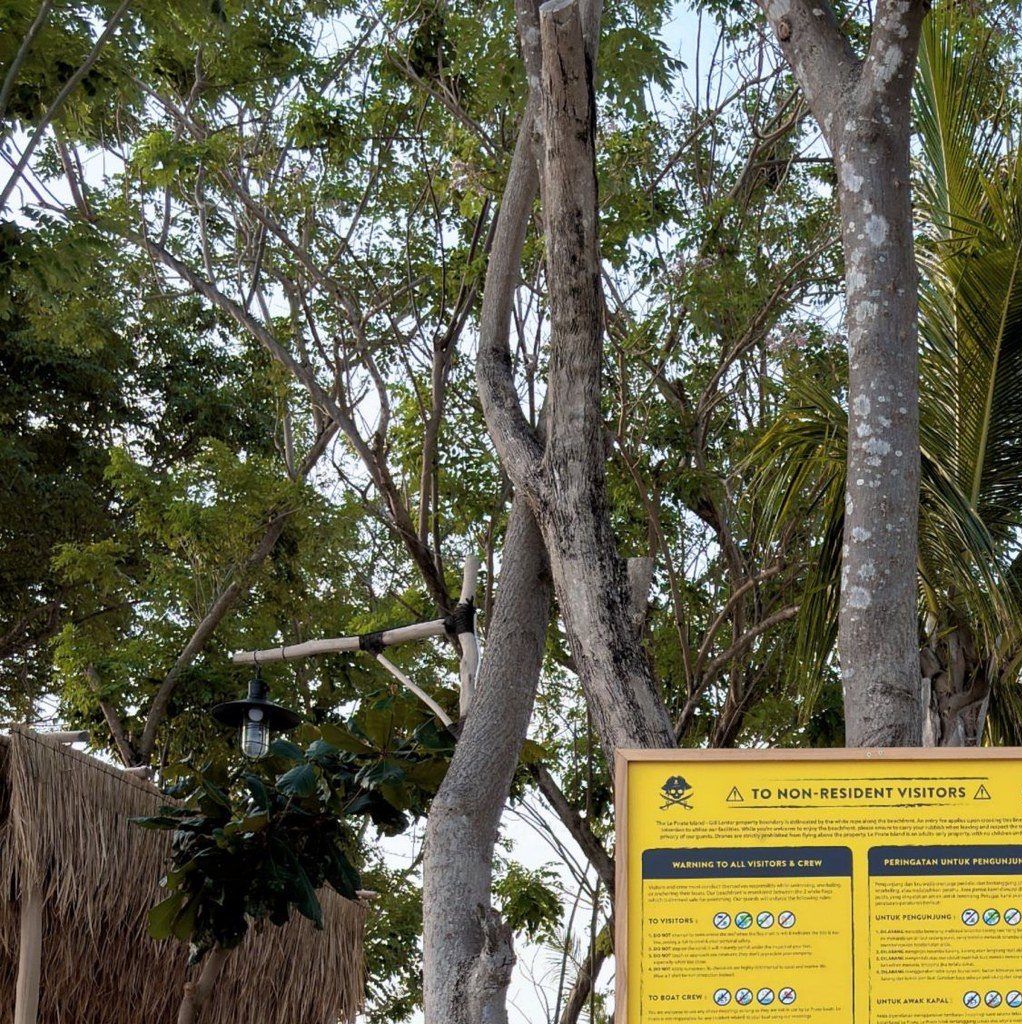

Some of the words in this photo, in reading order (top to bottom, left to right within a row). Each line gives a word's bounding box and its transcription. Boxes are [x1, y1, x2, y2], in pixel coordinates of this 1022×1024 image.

[752, 788, 771, 799] TO
[777, 787, 893, 799] NON-RESIDENT
[897, 786, 966, 798] VISITORS
[672, 861, 714, 869] WARNING
[730, 860, 745, 868] ALL
[747, 860, 787, 868] VISITORS
[797, 859, 822, 867] CREW
[884, 858, 938, 866] PERINGATAN
[941, 858, 970, 866] UNTUK
